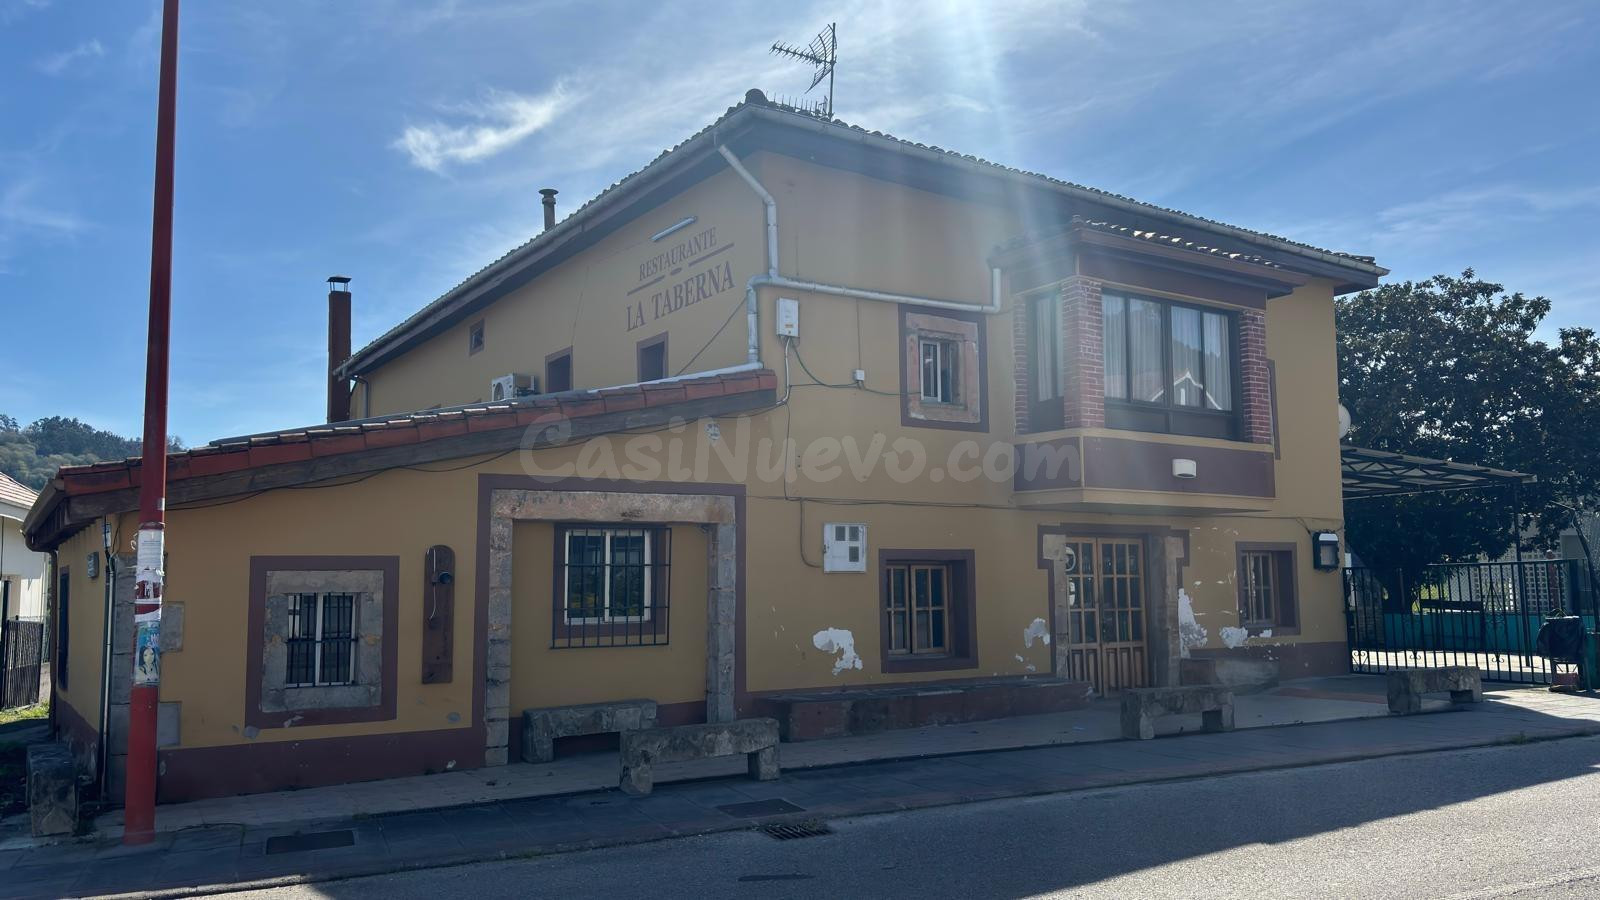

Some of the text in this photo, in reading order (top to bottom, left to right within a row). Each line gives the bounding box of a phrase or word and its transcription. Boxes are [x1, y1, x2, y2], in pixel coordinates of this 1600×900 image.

[639, 226, 717, 281] RESTAURANTE
[626, 260, 736, 332] LA TABERNA
